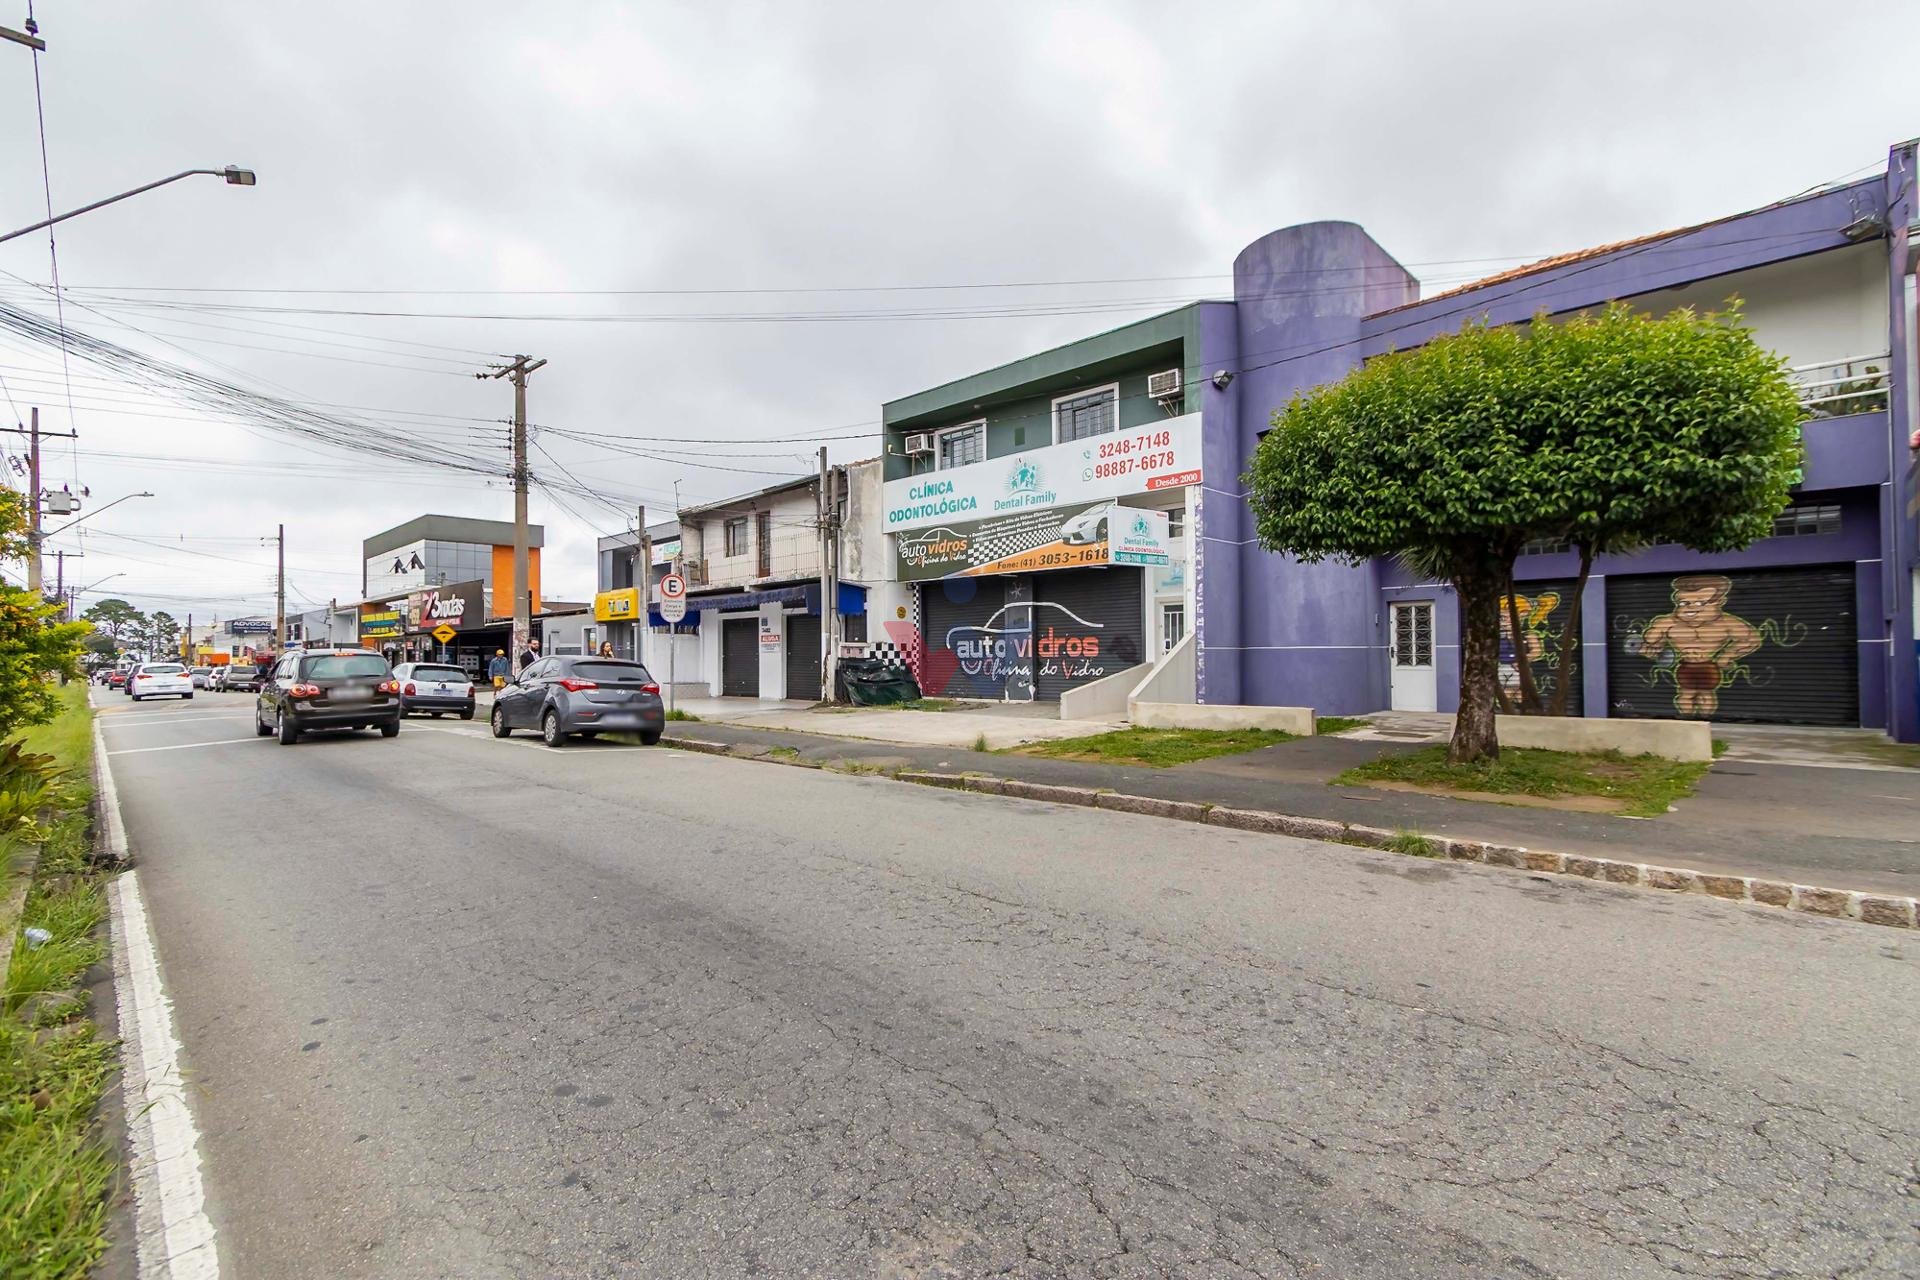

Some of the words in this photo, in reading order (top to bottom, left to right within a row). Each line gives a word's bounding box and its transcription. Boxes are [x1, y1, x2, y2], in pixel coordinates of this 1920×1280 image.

[1099, 431, 1170, 459] 3248-7148
[1095, 451, 1174, 479] 98887-6678
[909, 480, 954, 501] CLÍNICA
[1155, 477, 1179, 488] Desde
[1179, 473, 1198, 484] 2000
[889, 496, 977, 524] ODONTOLÓGICA
[994, 494, 1024, 511] Dental
[1025, 490, 1057, 506] Family
[902, 543, 927, 558] auto
[927, 538, 968, 555] vidros
[1124, 536, 1142, 546] Dental
[1142, 537, 1159, 547] Family
[997, 561, 1019, 570] Fone:
[1020, 558, 1037, 567] (41)
[1038, 548, 1109, 566] 3053-1618
[669, 579, 677, 593] E
[956, 636, 1006, 659] auto
[1013, 626, 1099, 658] vidros
[984, 658, 1032, 682] Oficina
[1040, 658, 1058, 676] do
[1062, 658, 1104, 680] Vidro
